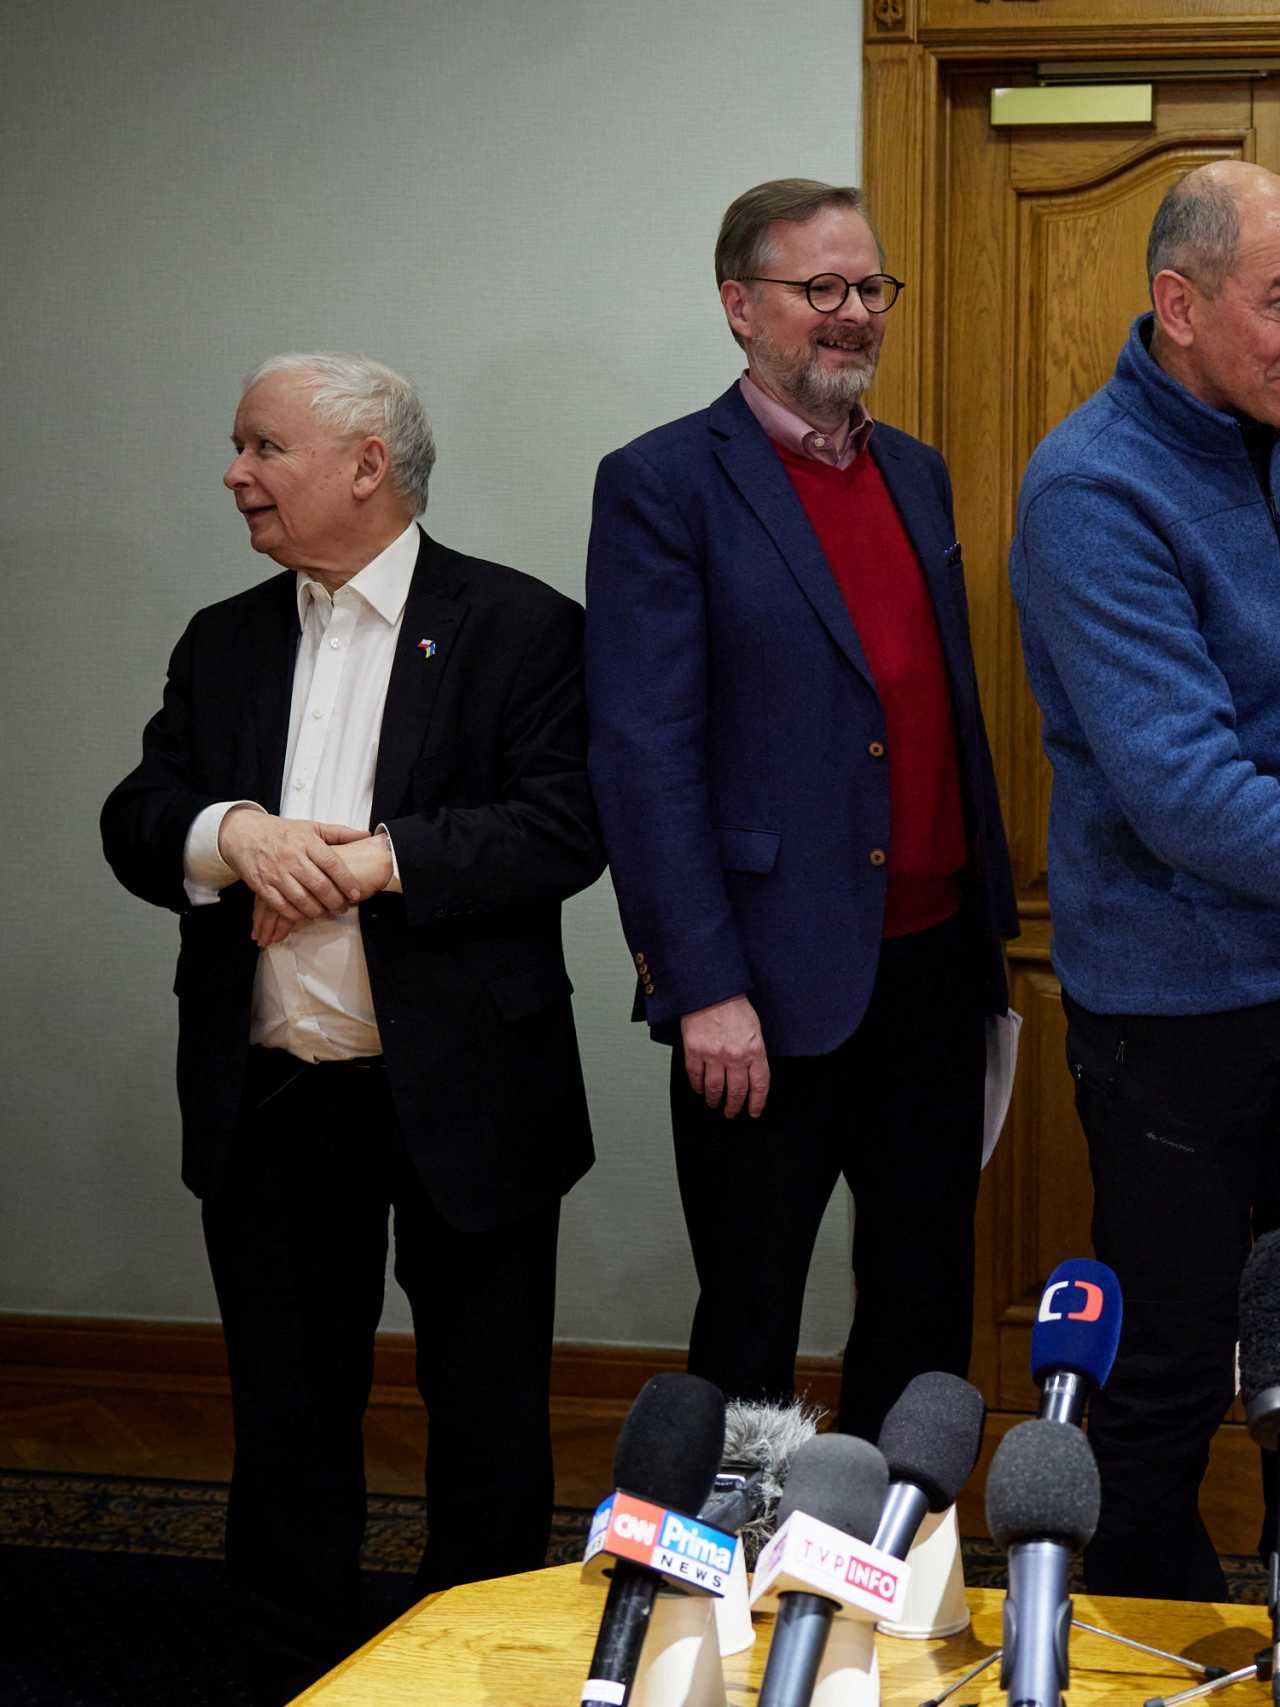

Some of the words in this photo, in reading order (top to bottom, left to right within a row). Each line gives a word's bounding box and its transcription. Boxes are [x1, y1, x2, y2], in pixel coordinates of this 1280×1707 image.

[613, 1513, 657, 1546] CNN
[661, 1515, 732, 1572] Prima
[660, 1554, 722, 1588] NEWS
[804, 1539, 845, 1571] TVP
[850, 1561, 896, 1599] INFO
